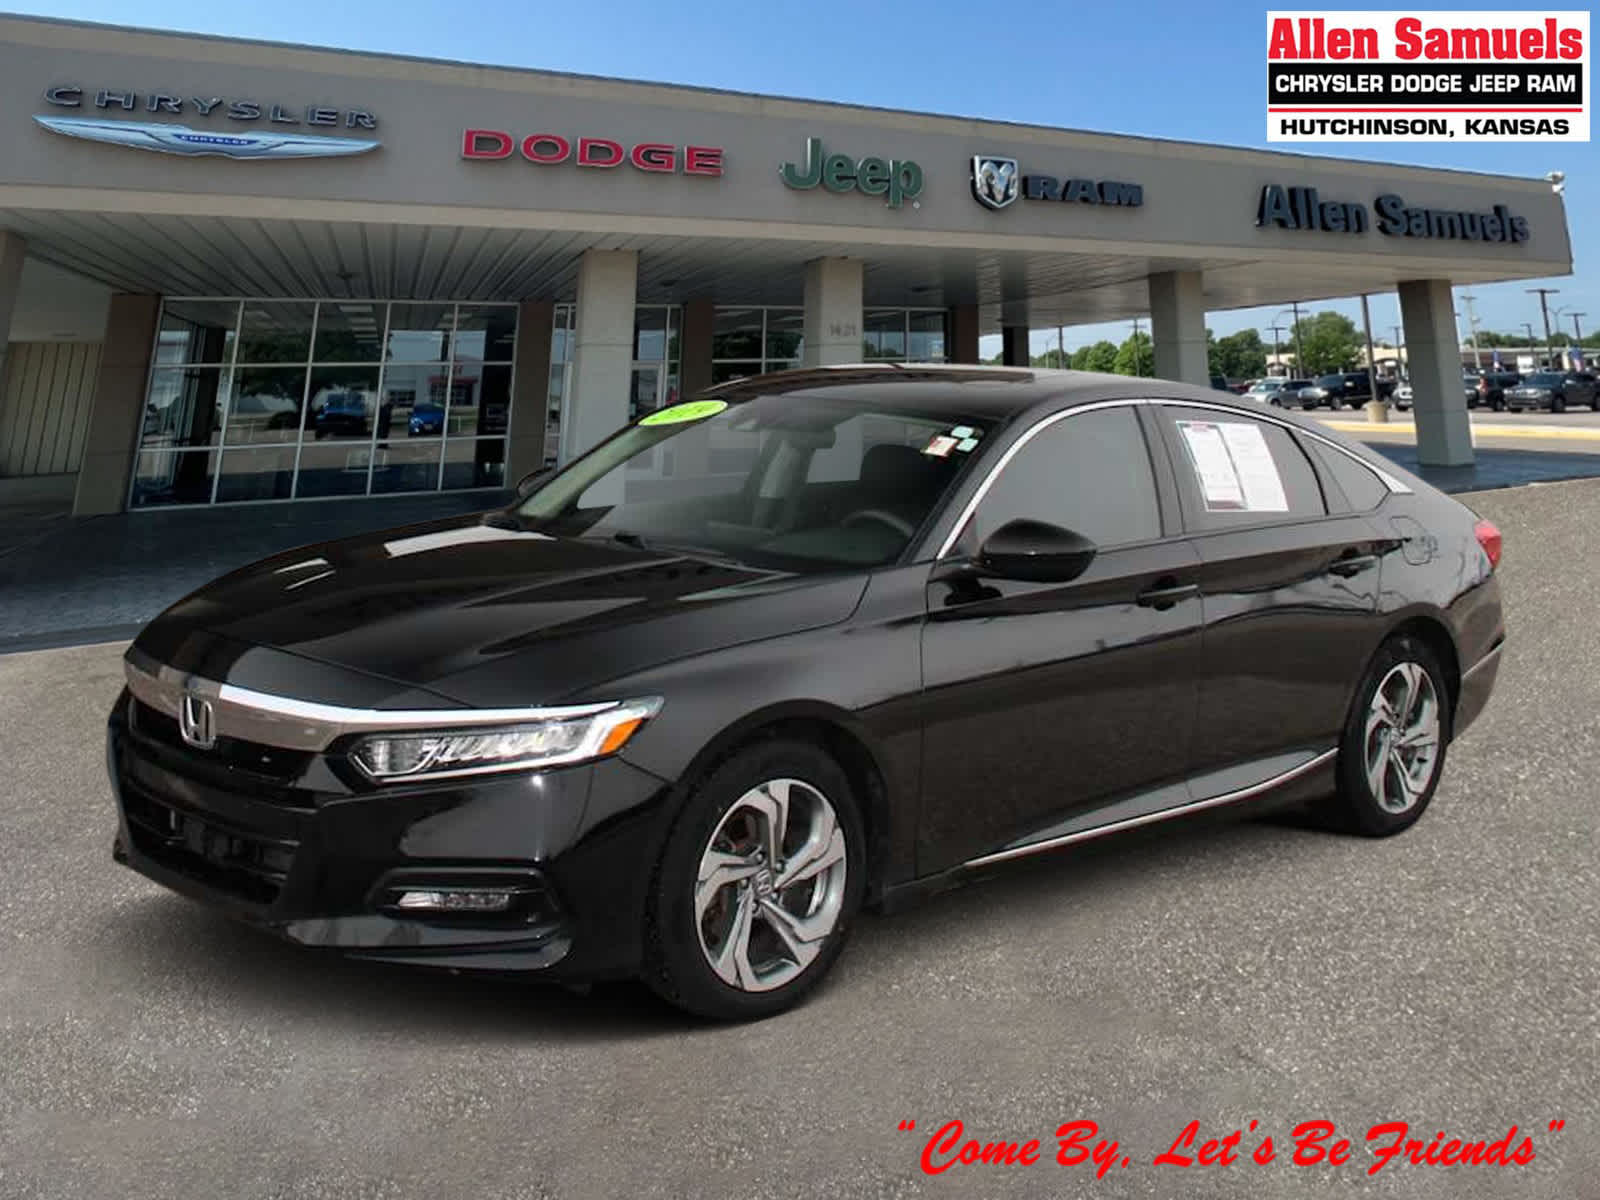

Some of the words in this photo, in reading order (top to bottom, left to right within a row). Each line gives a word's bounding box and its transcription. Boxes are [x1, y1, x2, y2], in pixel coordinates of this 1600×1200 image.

[45, 86, 378, 129] CHRYSLER
[461, 128, 724, 177] DODGE
[782, 137, 923, 209] Jeep
[1023, 174, 1145, 207] RAM
[1256, 184, 1368, 234] Allen
[1374, 194, 1531, 243] Samuels
